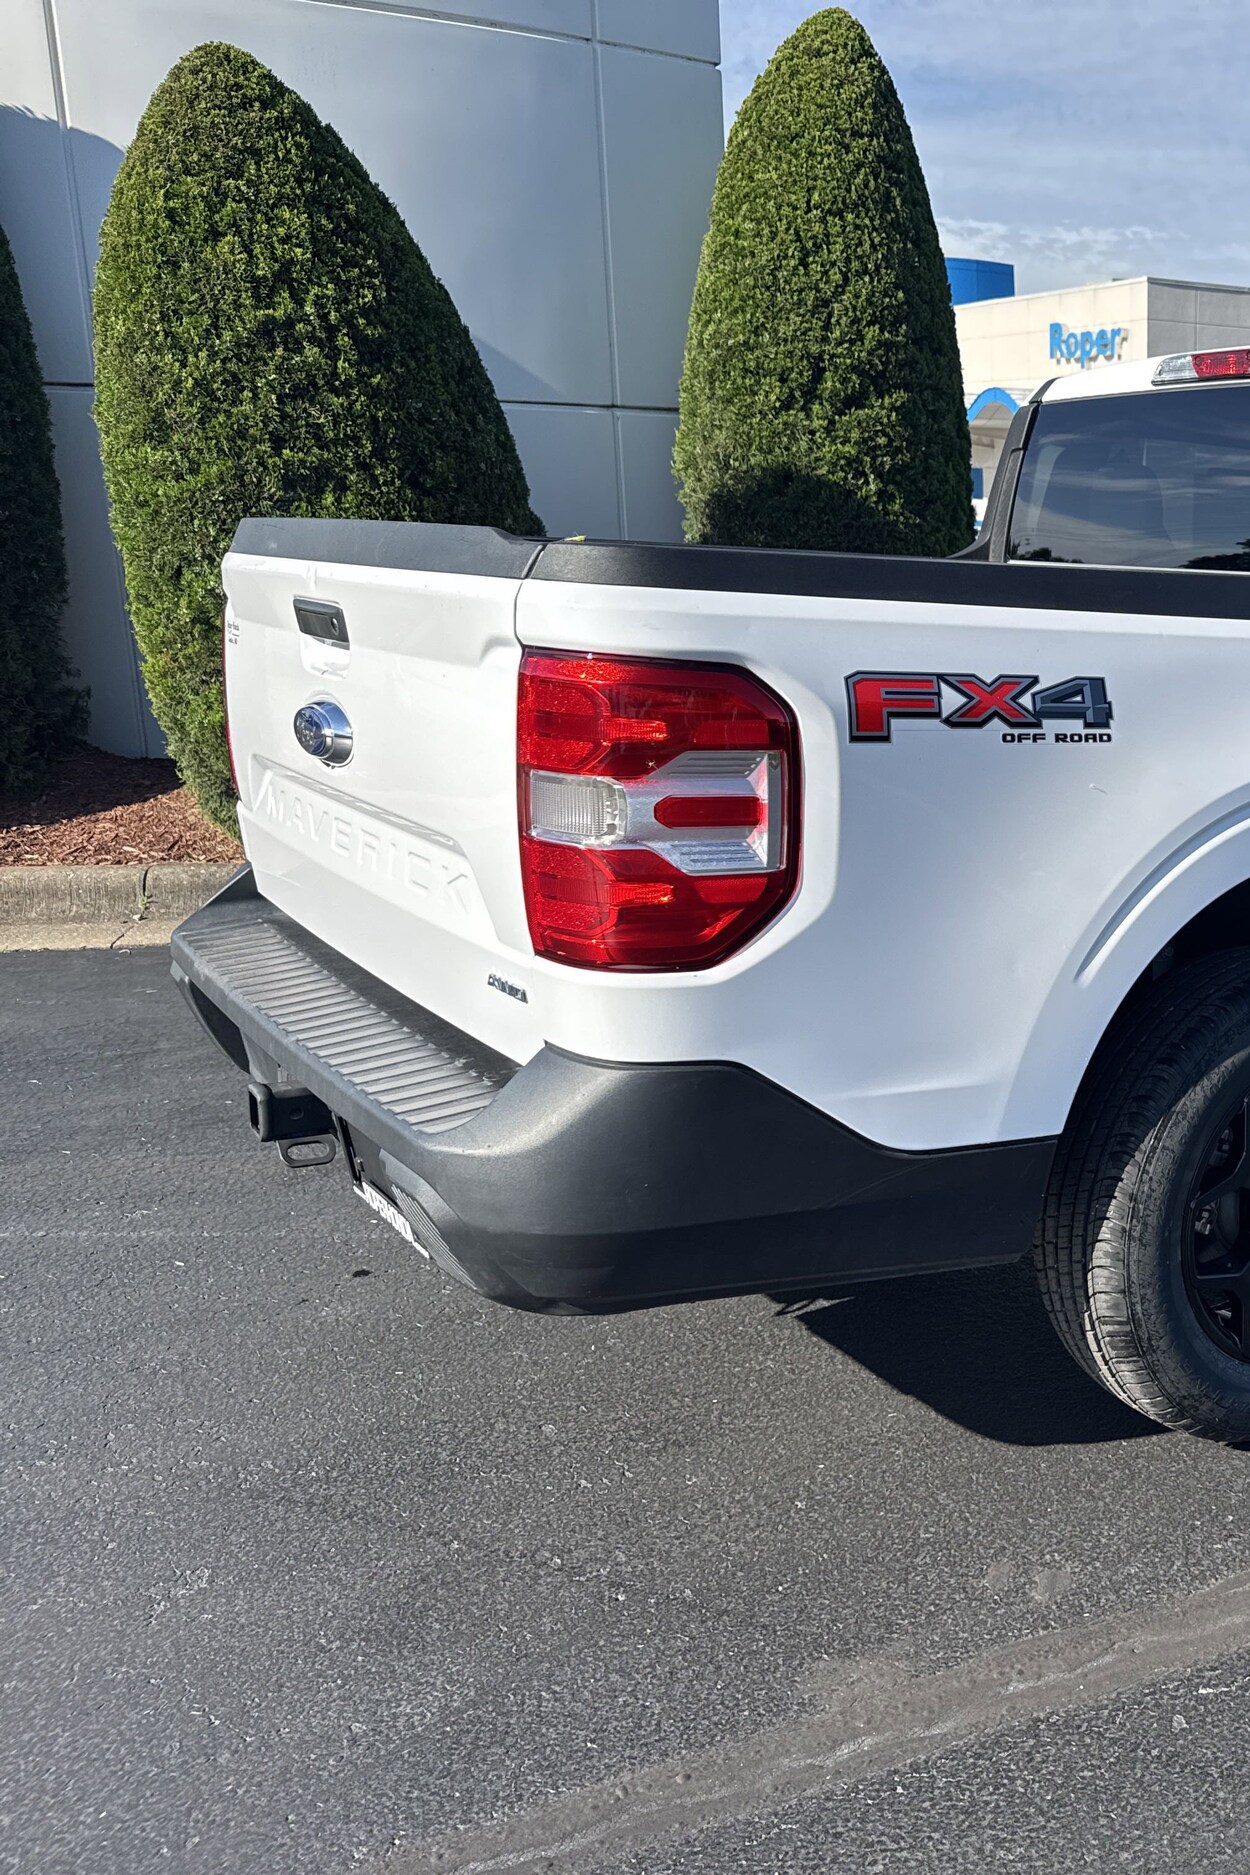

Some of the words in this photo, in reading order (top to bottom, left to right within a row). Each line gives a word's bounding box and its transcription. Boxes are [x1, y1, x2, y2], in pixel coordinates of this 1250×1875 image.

[1049, 322, 1121, 369] Roper
[843, 670, 1113, 744] FX4
[1001, 733, 1046, 744] OFF
[1054, 733, 1112, 744] ROAD
[266, 783, 473, 916] MAVERICK
